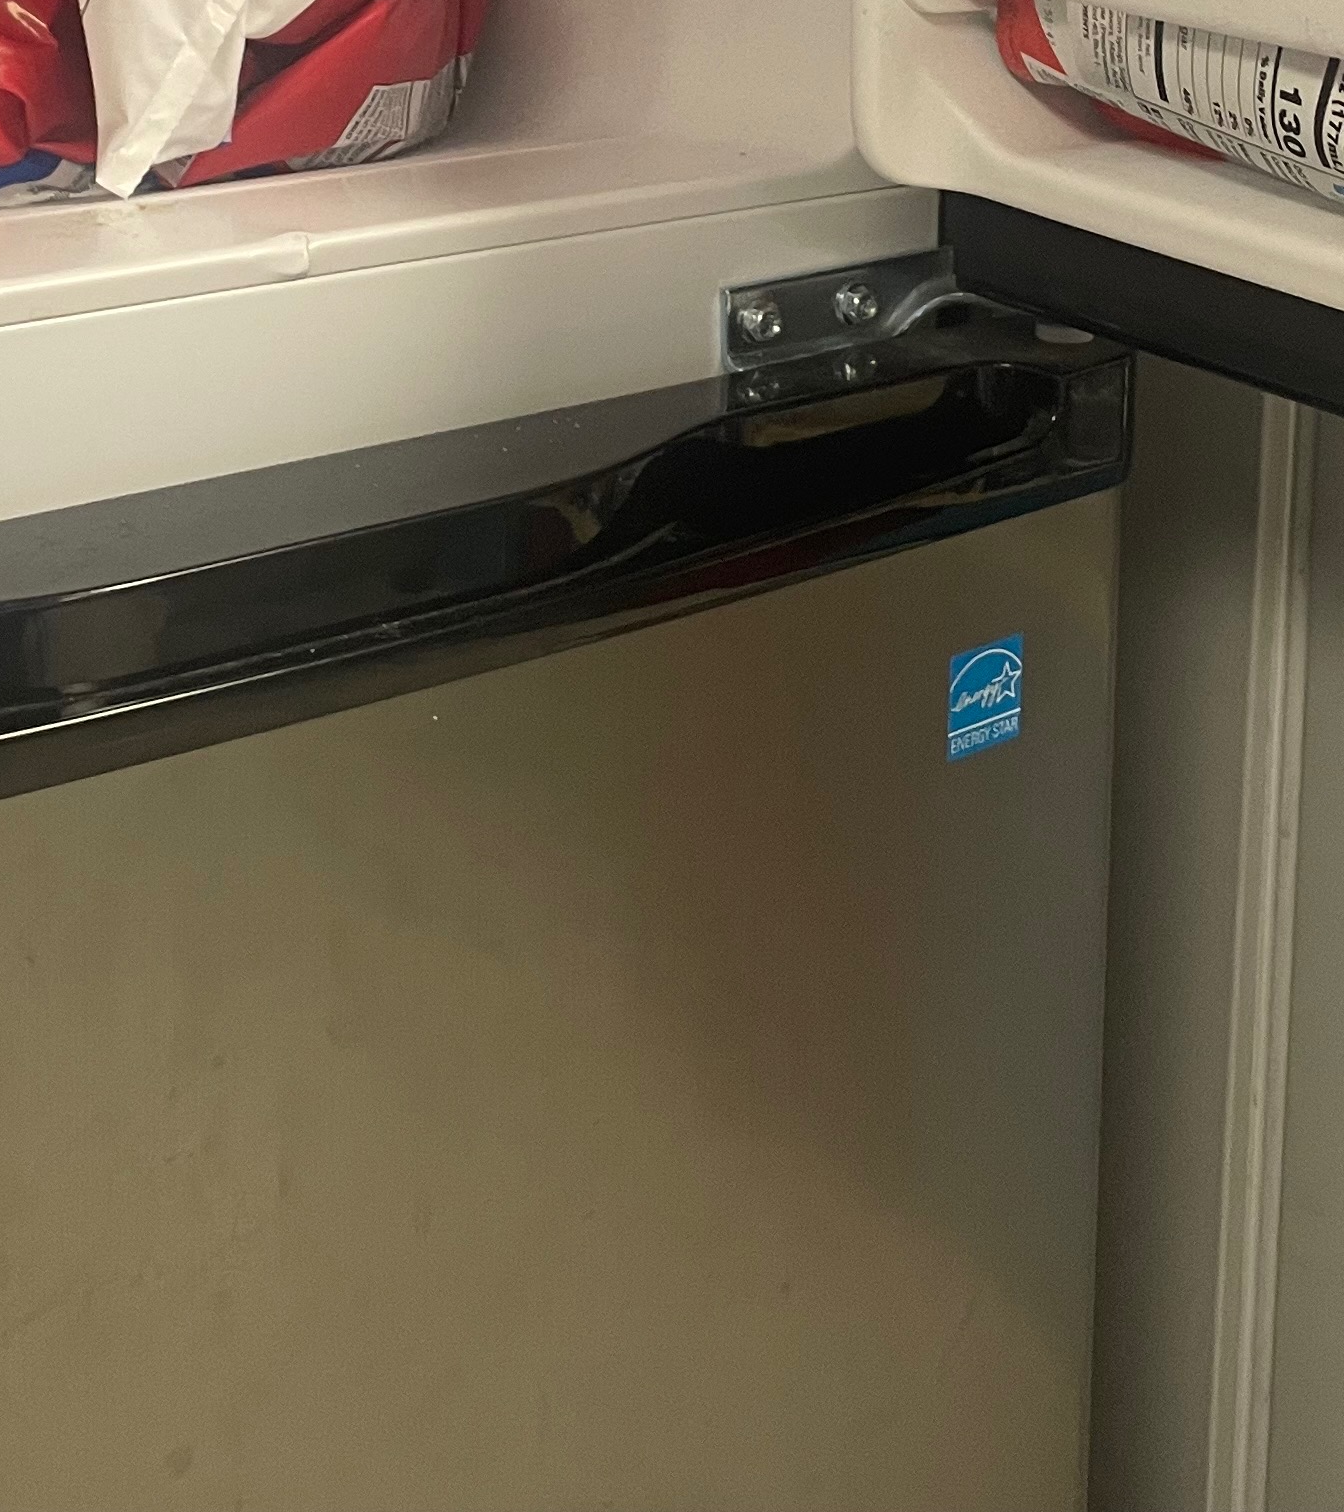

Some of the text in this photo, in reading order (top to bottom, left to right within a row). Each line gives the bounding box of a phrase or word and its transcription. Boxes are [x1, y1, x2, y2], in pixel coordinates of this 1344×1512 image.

[1278, 87, 1307, 158] 130
[950, 716, 1020, 754] ENERGY STAR
